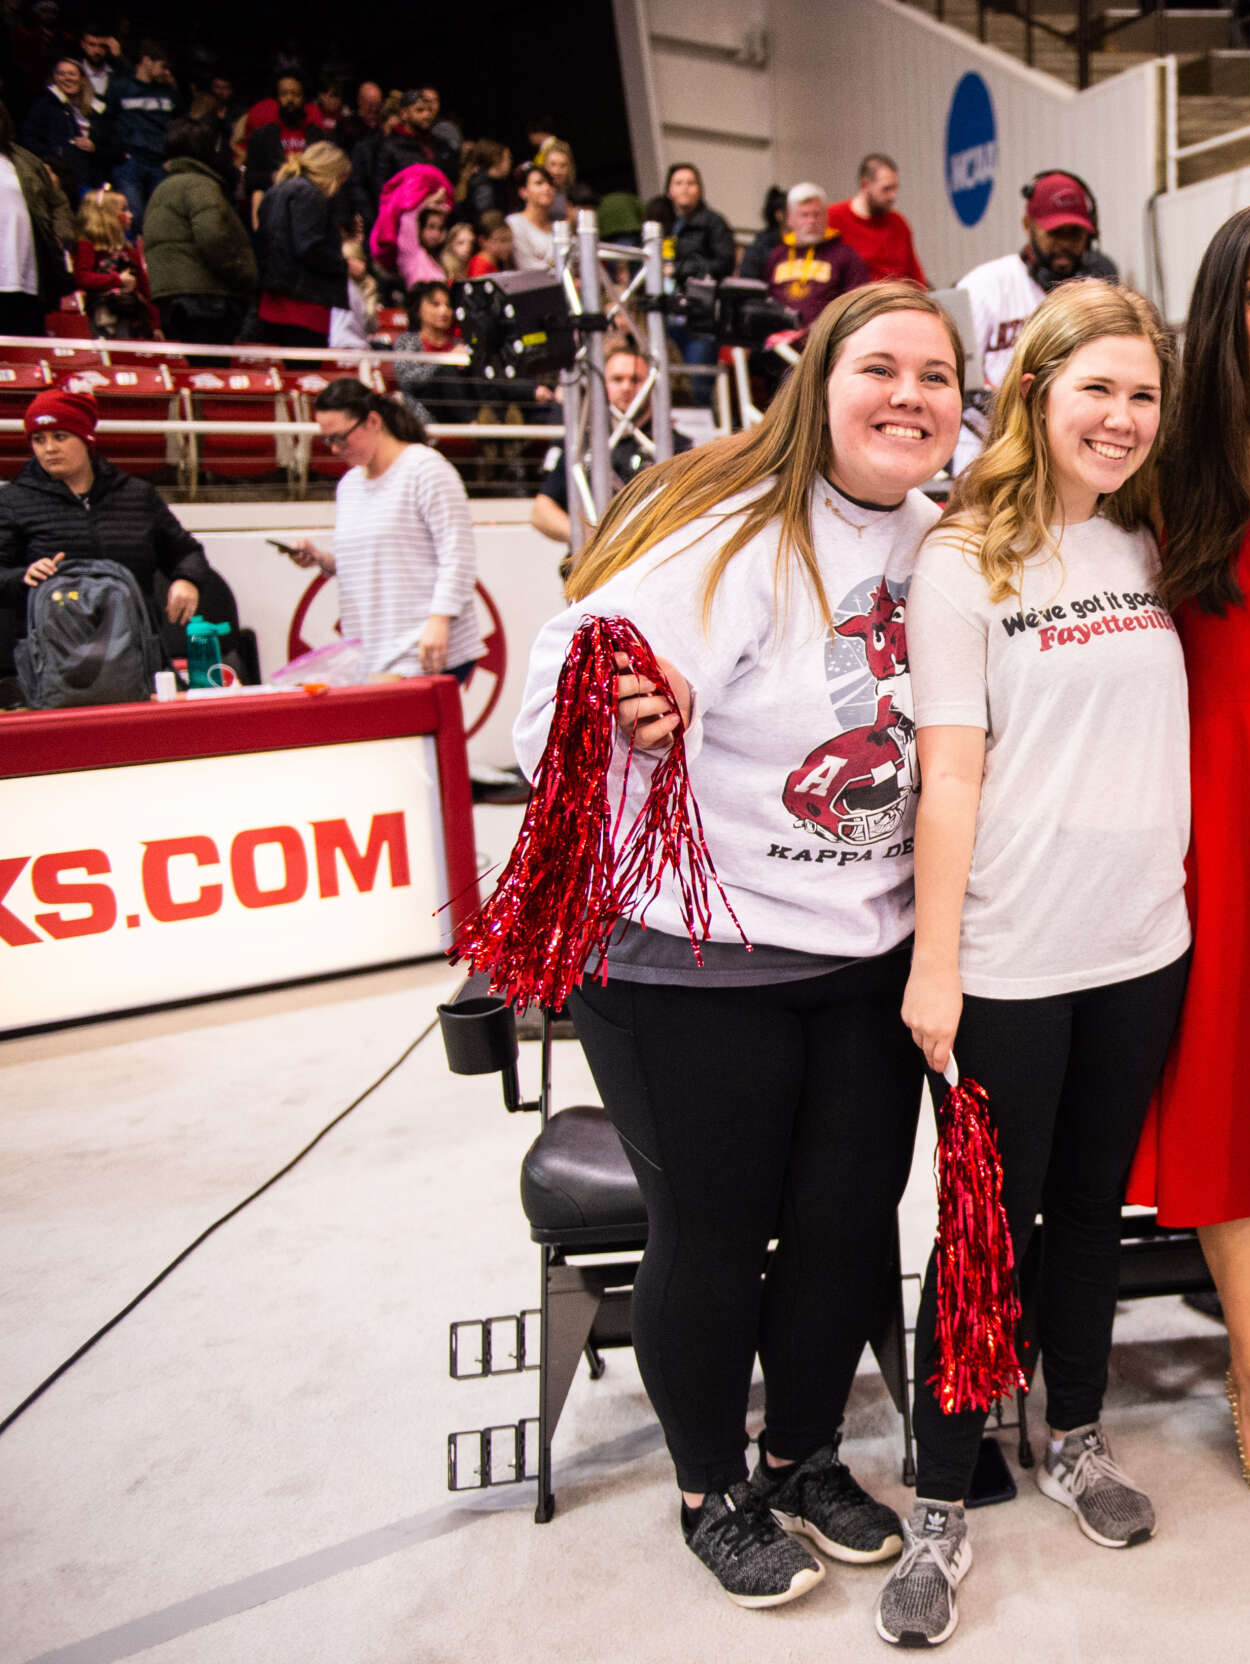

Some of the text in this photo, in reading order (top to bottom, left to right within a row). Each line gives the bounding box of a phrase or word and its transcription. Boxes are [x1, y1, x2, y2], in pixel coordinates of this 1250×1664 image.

[949, 140, 997, 193] NCAA
[1001, 604, 1067, 638] We've
[1070, 594, 1105, 619] got
[1103, 591, 1123, 610] it
[793, 754, 849, 797] A
[766, 843, 873, 866] KAPPA
